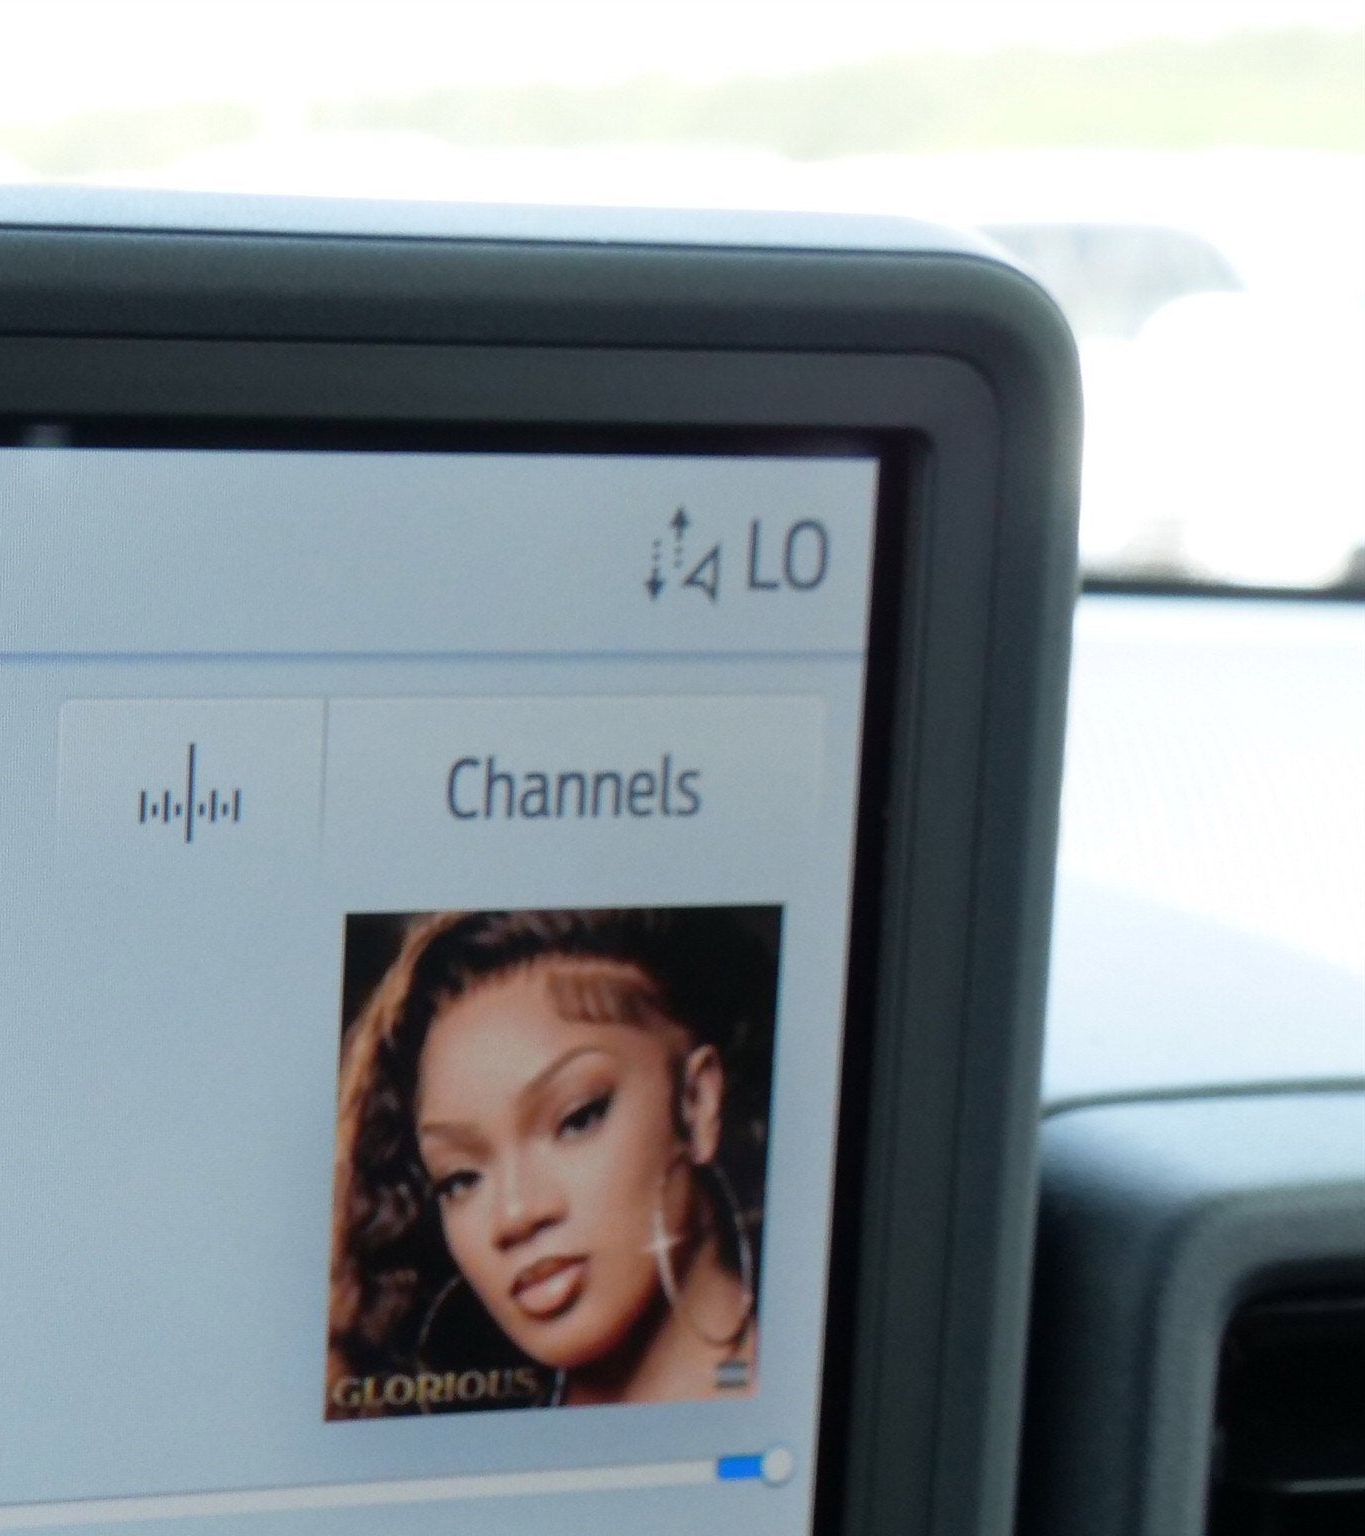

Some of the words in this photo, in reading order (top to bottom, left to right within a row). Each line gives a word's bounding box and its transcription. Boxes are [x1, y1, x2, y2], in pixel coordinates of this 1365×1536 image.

[745, 517, 831, 594] LO
[445, 754, 703, 822] Channels
[330, 1366, 540, 1409] GLORIOUS
